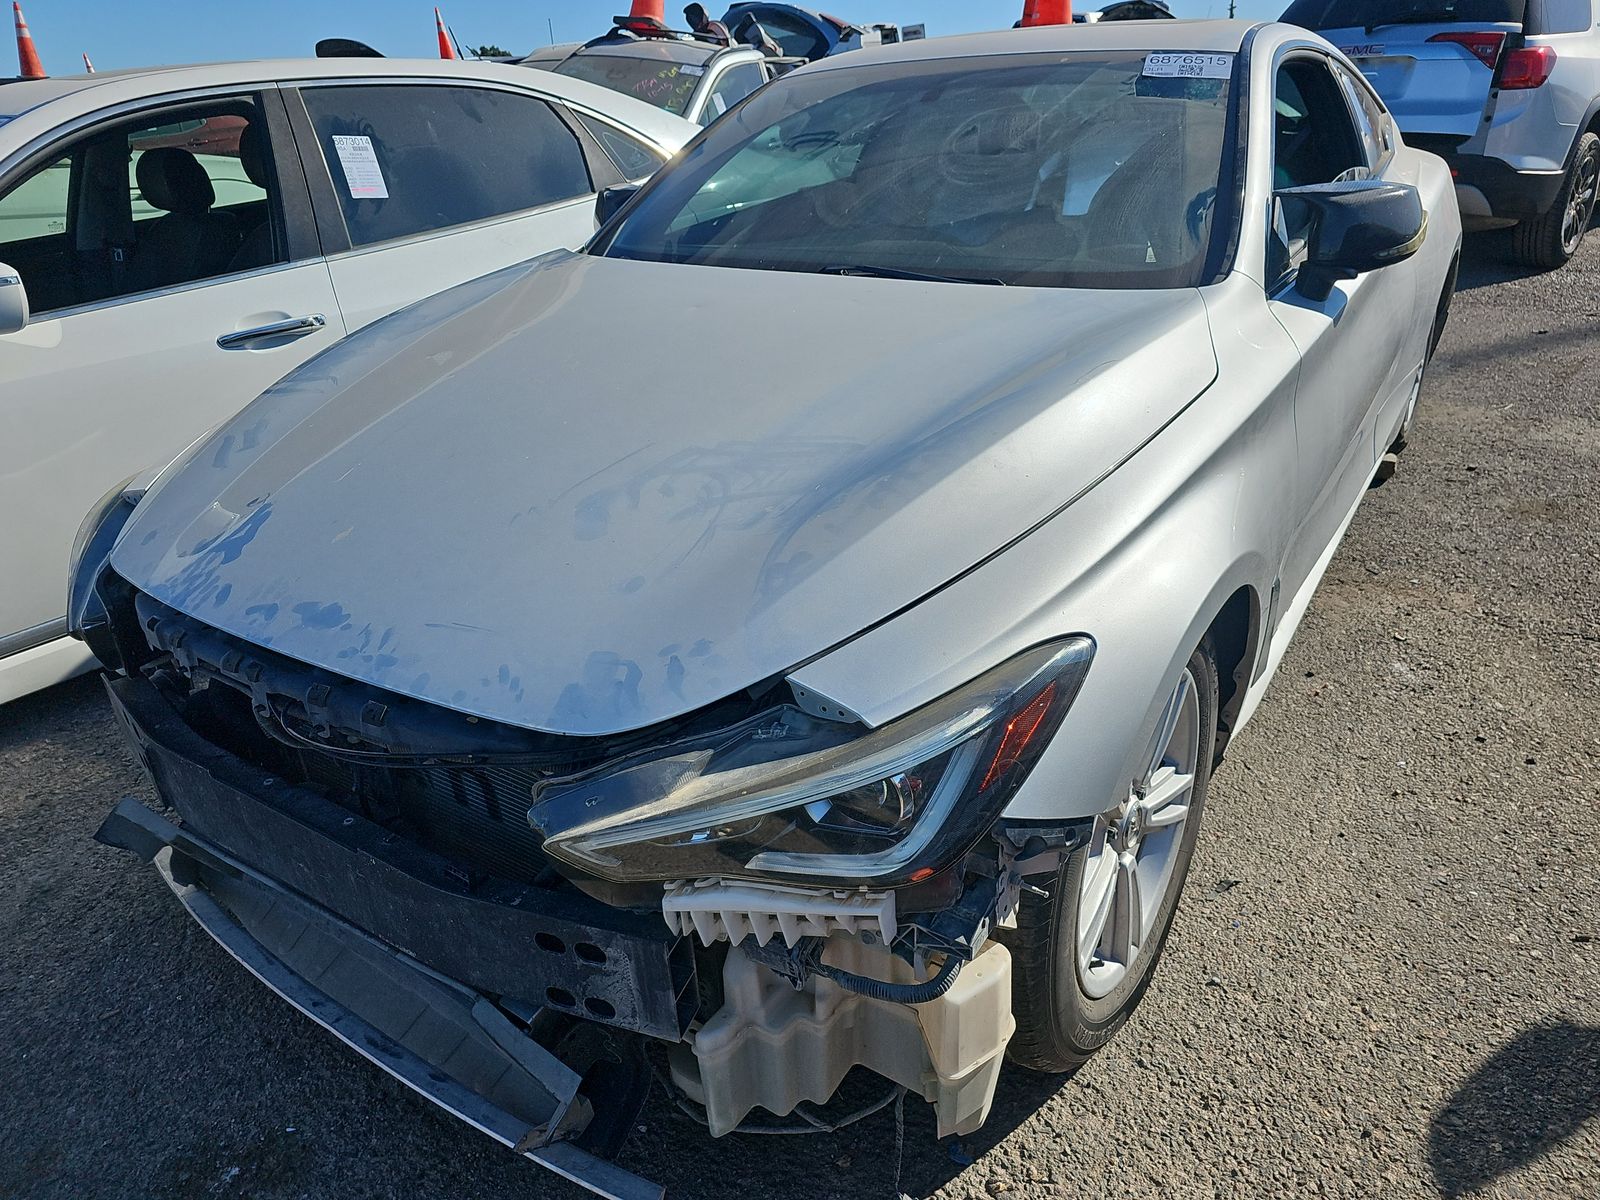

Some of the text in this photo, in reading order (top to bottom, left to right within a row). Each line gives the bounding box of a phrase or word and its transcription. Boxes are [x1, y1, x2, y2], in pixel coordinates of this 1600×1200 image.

[1340, 44, 1385, 56] GMC
[1149, 55, 1227, 66] 6876515
[333, 137, 371, 146] 6873014
